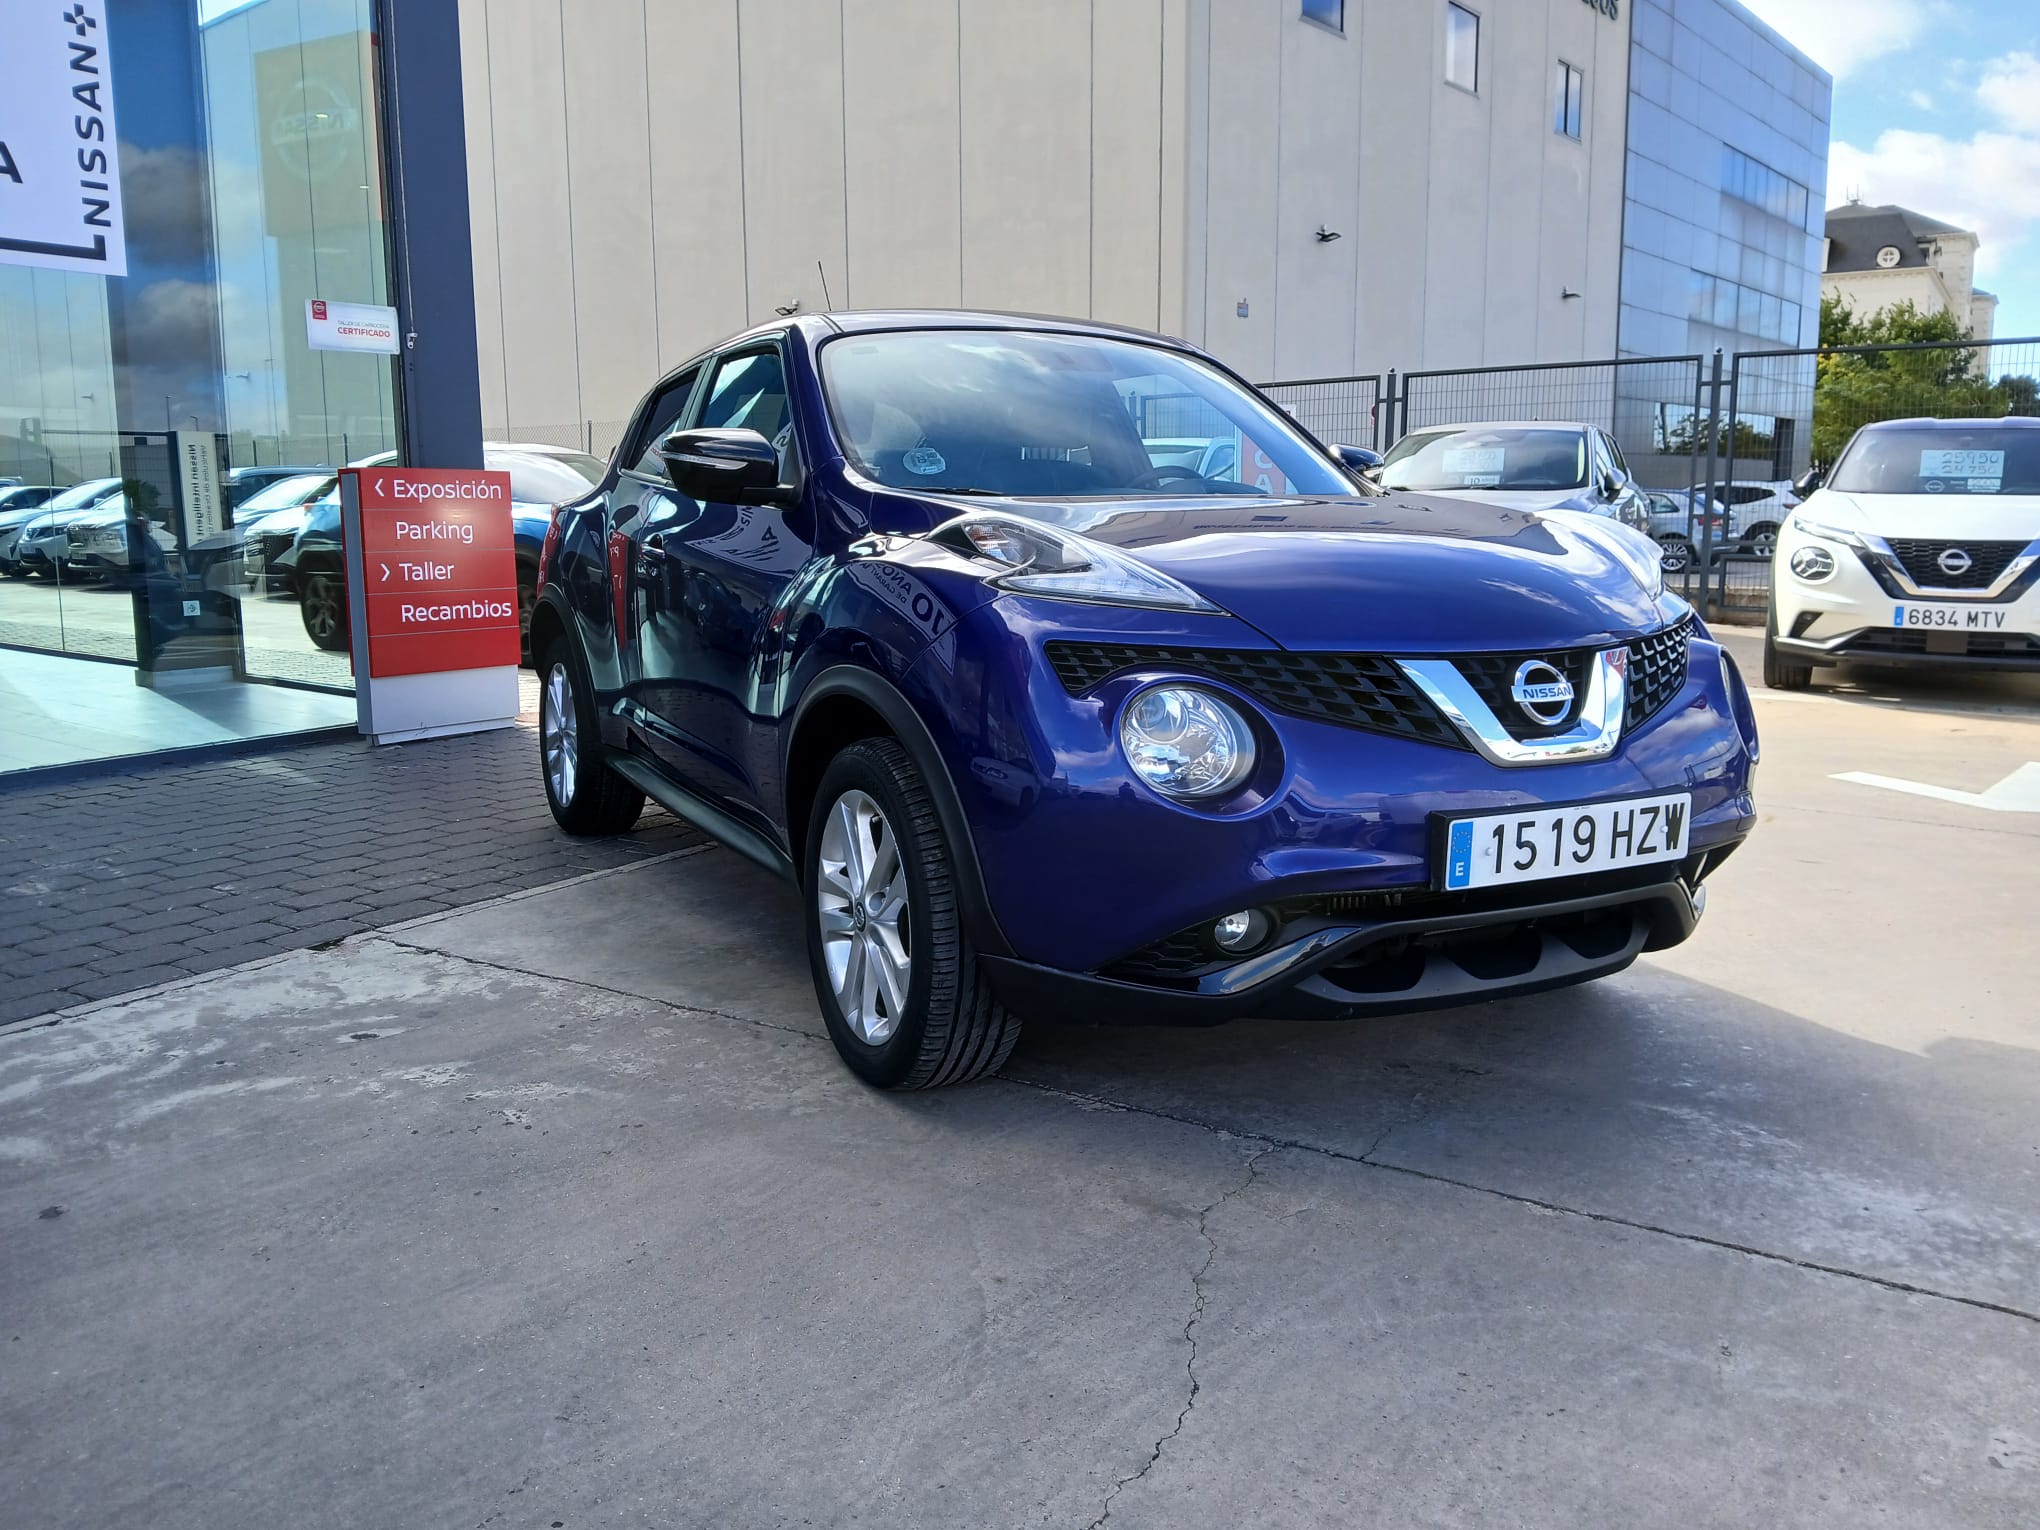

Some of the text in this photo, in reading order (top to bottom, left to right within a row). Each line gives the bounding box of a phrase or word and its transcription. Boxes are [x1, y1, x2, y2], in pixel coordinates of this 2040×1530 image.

[67, 41, 111, 227] NISSAN
[337, 327, 391, 338] CERTIFICADO
[393, 479, 502, 503] Exposición
[395, 521, 474, 543] Parking
[398, 561, 455, 582] Taller
[401, 600, 512, 623] Recambios
[1908, 608, 1960, 628] 6834
[1966, 610, 2006, 628] MTV
[1522, 683, 1574, 699] NISSAN
[1454, 801, 1686, 877] E 1519 HZW
